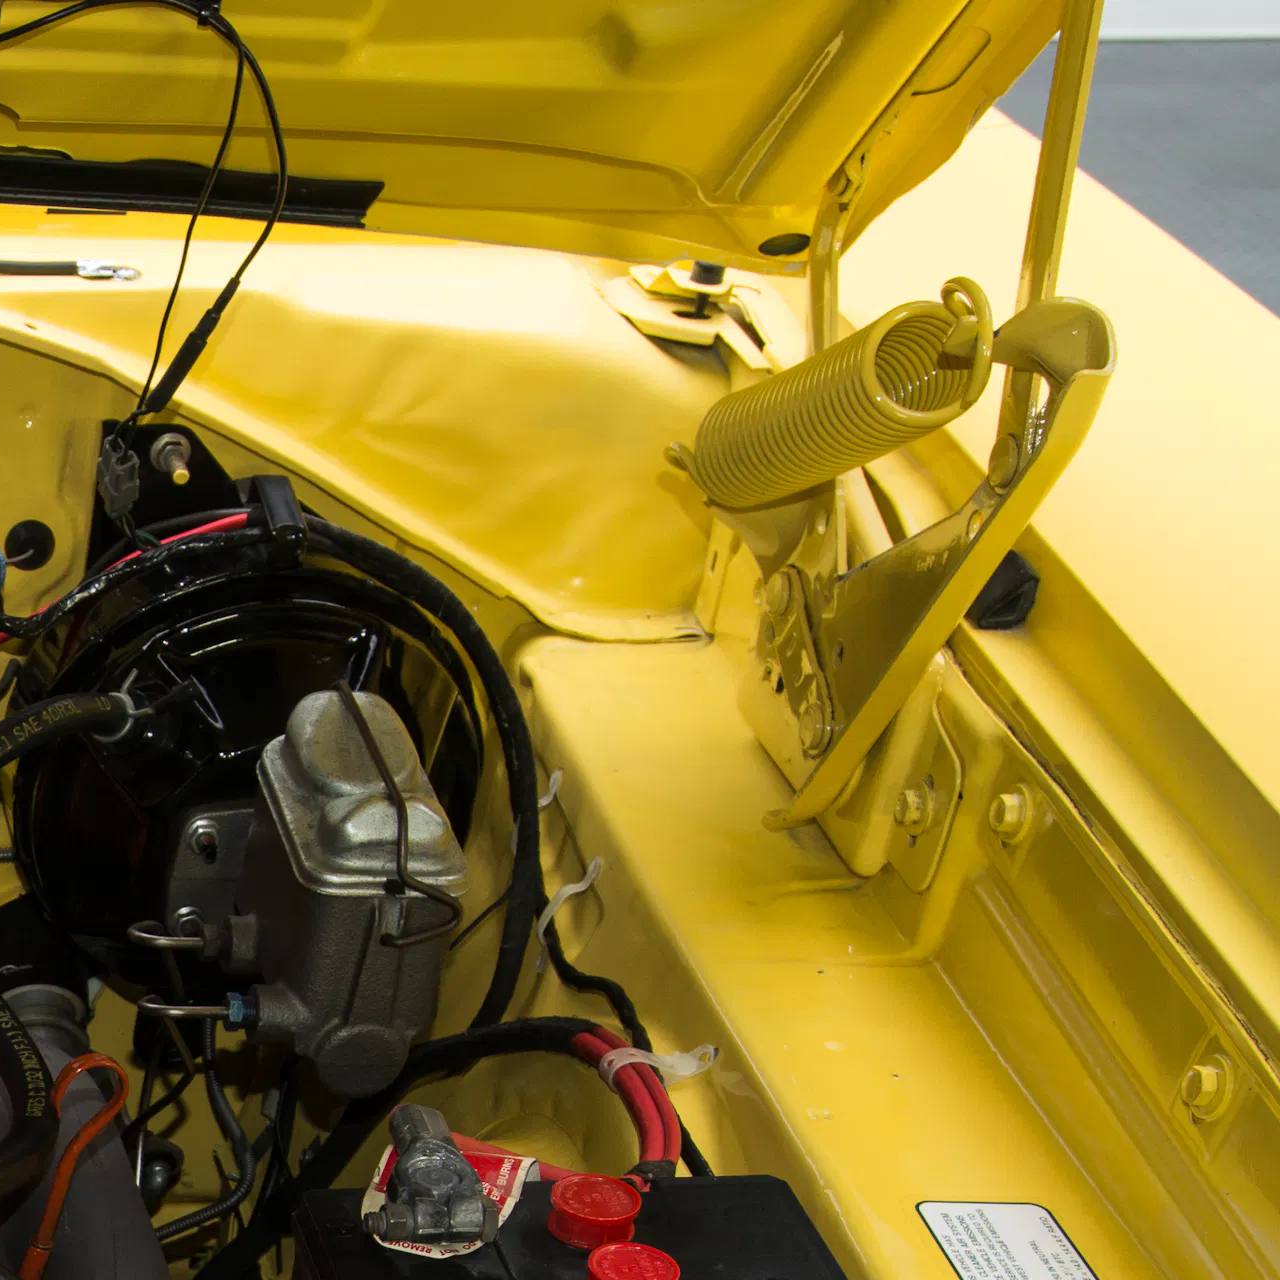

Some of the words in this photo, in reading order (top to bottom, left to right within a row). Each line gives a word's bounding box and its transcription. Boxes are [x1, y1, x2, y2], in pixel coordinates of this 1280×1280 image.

[12, 715, 43, 742] SAE
[496, 1157, 515, 1187] BURNS
[940, 1213, 961, 1236] SYSTEM
[955, 1215, 981, 1246] EMISSIONS
[976, 1209, 1000, 1238] EMISSIONS
[1039, 1217, 1056, 1232] RATIO
[462, 1240, 477, 1250] DO
[942, 1235, 955, 1246] HAS
[973, 1222, 997, 1250] REQUIRED
[440, 1247, 460, 1257] NOT
[950, 1248, 972, 1272] VEHICLE
[977, 1248, 998, 1272] VEHICLE
[996, 1240, 1016, 1262] VEHICLE
[1027, 1240, 1051, 1265] NEUTRAL
[964, 1250, 988, 1277] CLEANER
[997, 1258, 1018, 1280] SERVICE
